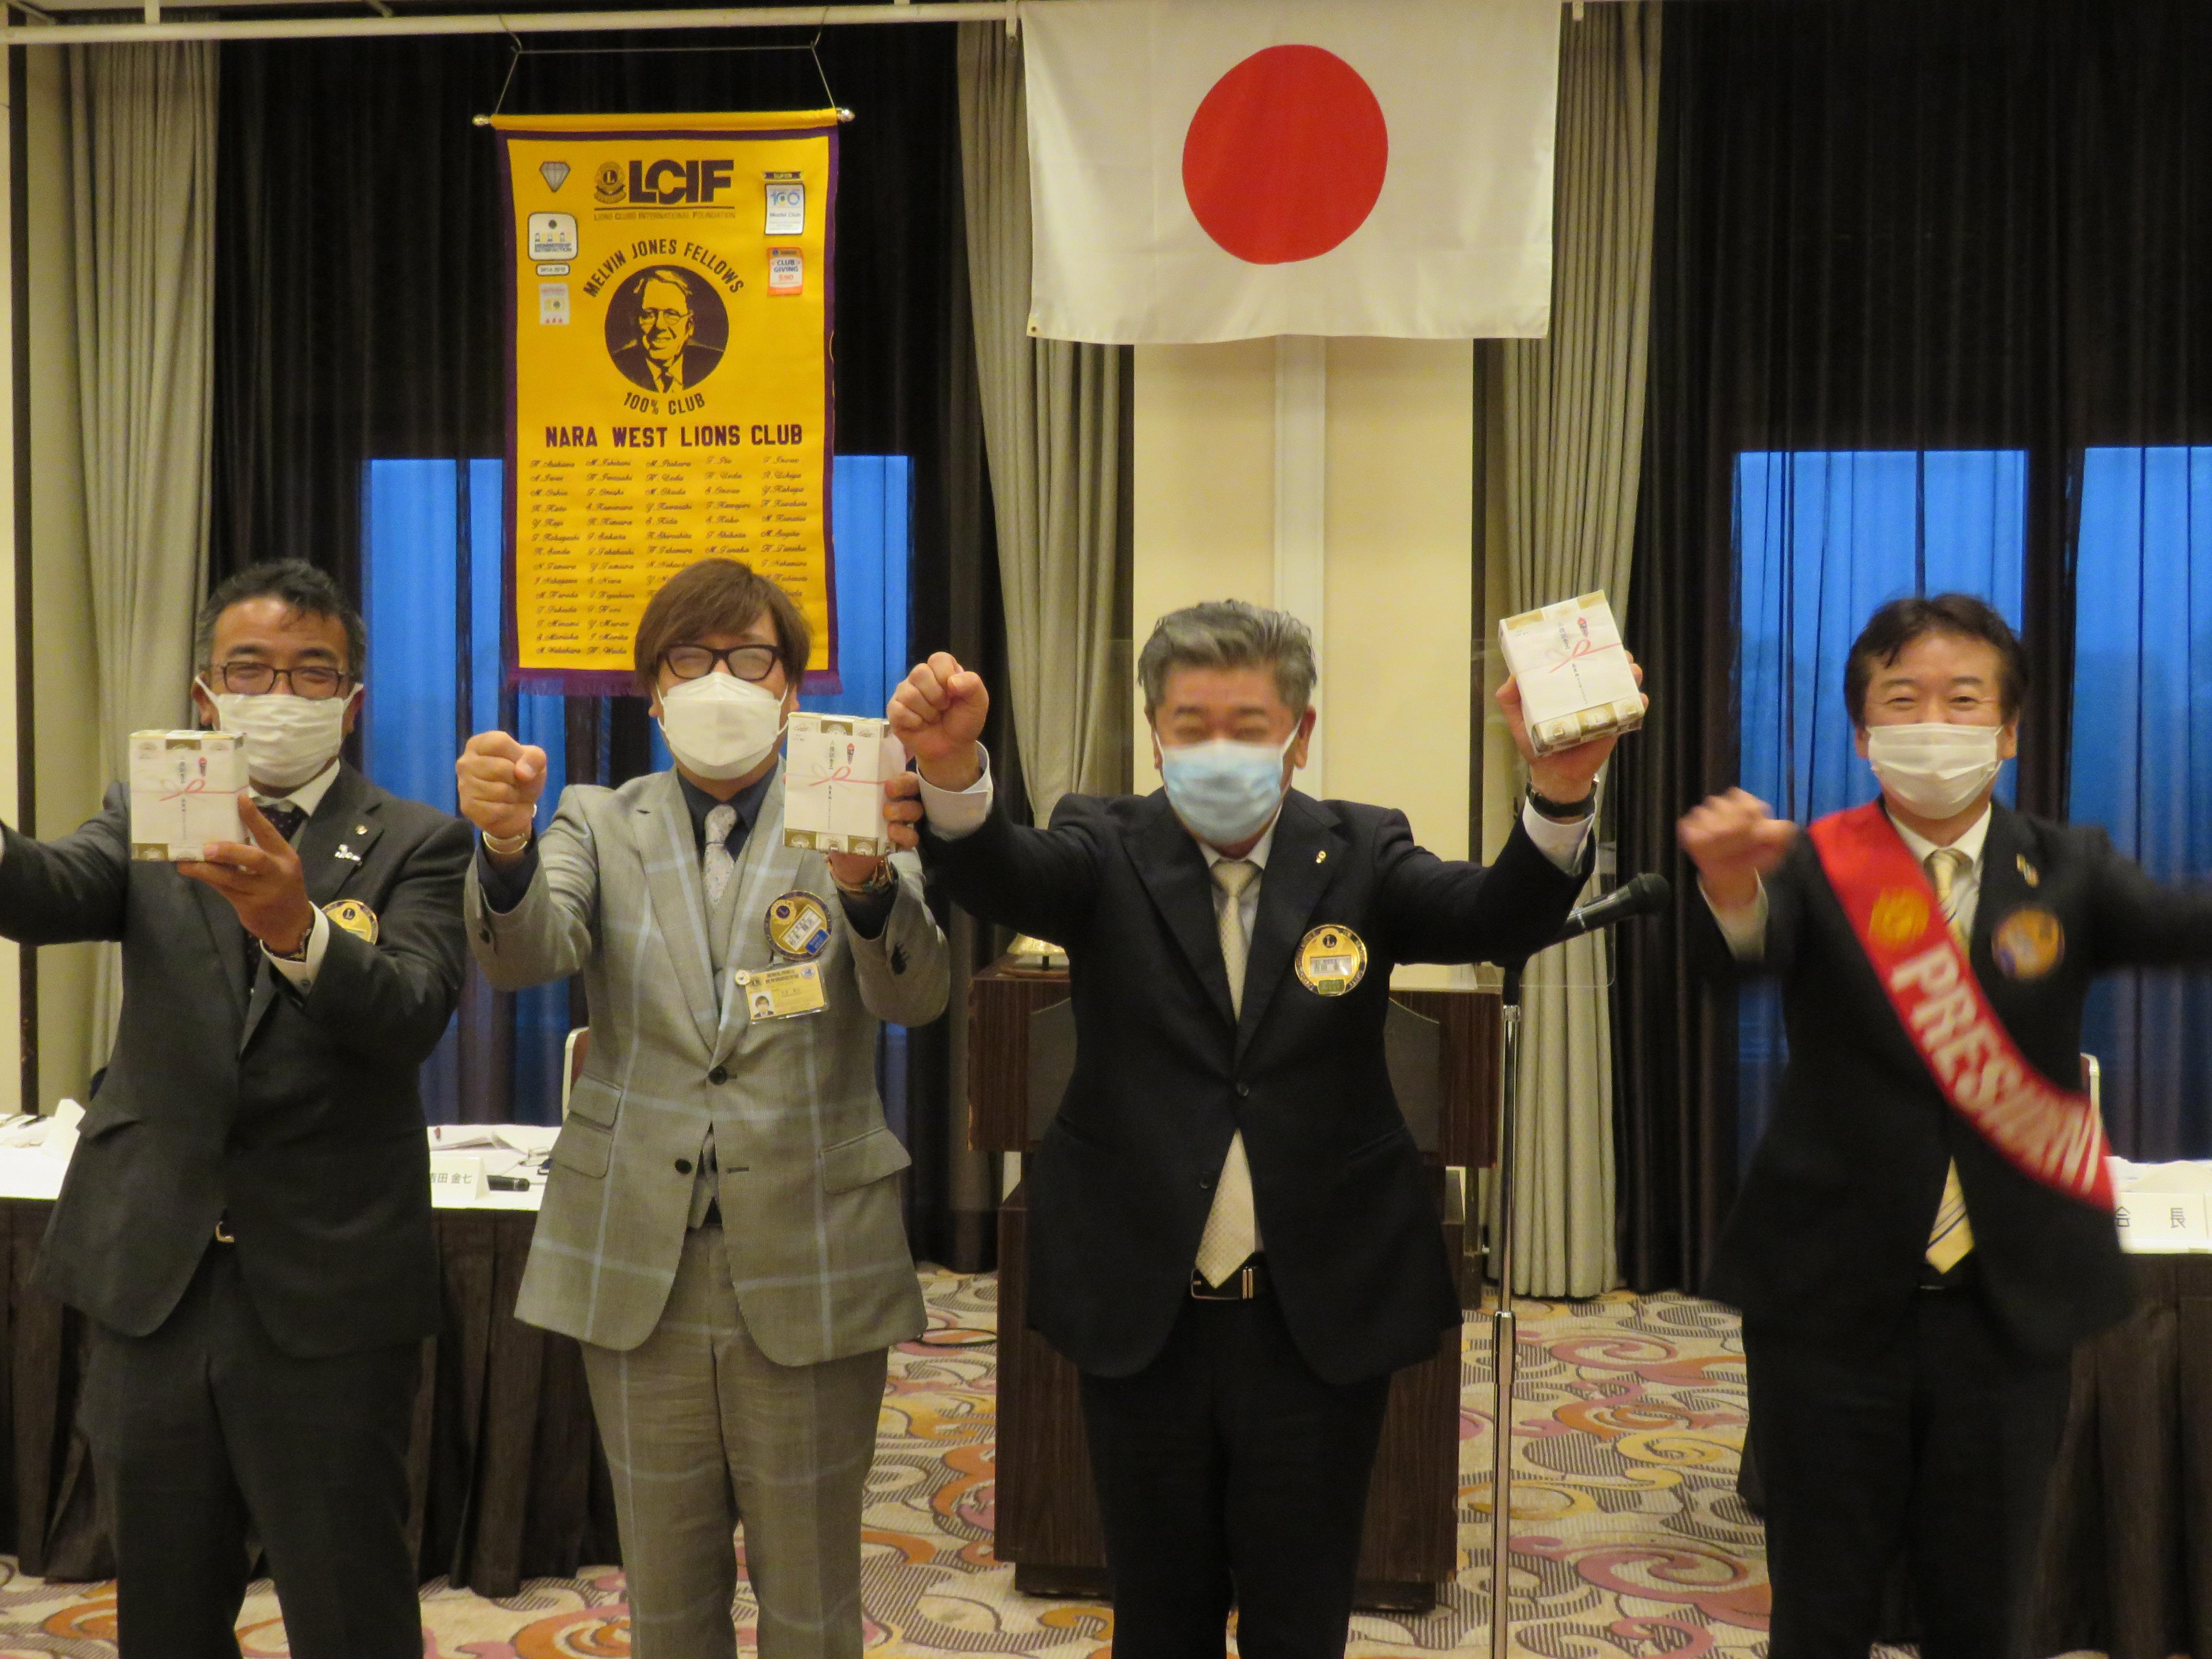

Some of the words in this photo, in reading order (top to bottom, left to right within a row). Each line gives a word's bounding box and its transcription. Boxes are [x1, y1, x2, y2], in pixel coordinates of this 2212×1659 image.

[628, 159, 734, 204] LCIF
[583, 250, 626, 298] MELVIN
[631, 239, 677, 259] JONES
[684, 242, 744, 293] FELLOWS
[624, 392, 659, 415] 100%
[668, 393, 706, 415] CLUB
[545, 426, 598, 448] NARA
[612, 426, 668, 448] WEST
[681, 425, 741, 447] LIONS
[751, 424, 803, 446] CLUB
[2170, 1207, 2186, 1228] 長
